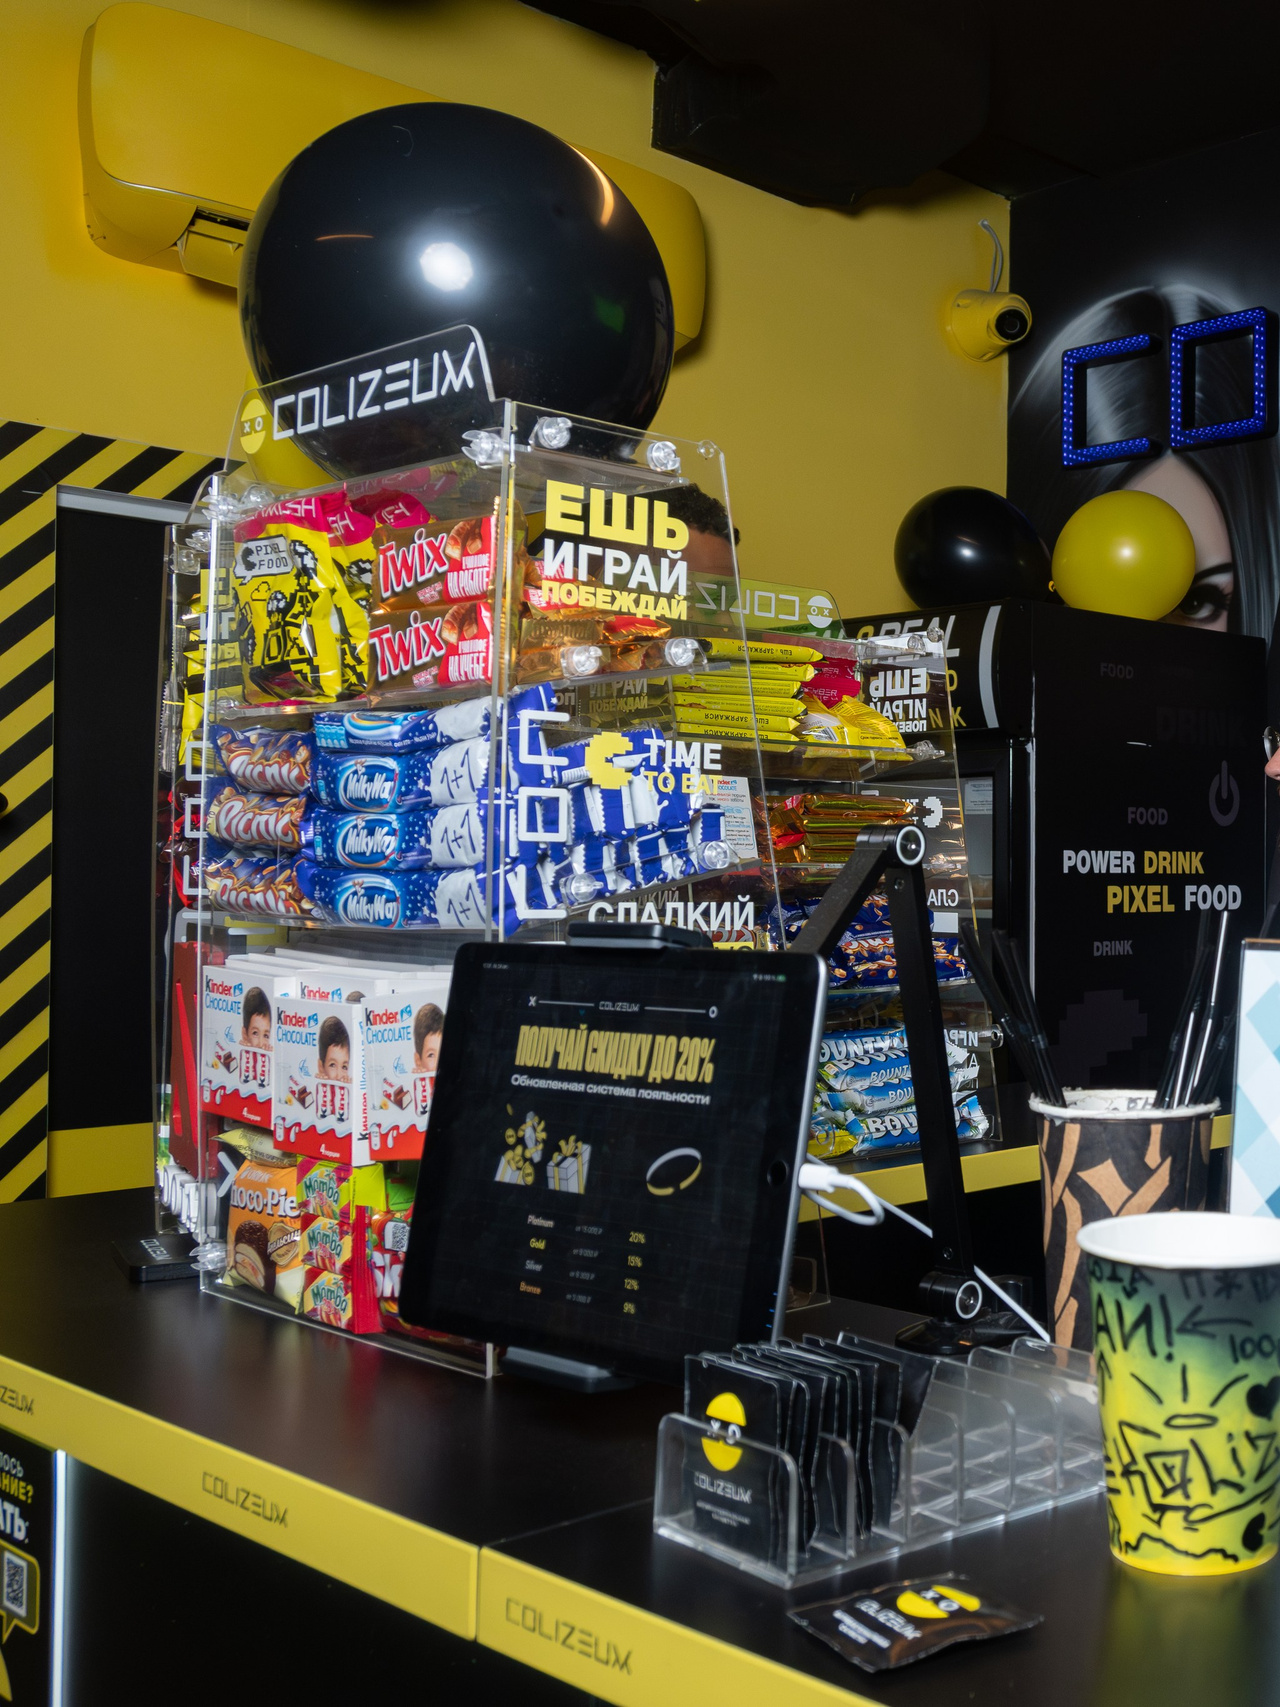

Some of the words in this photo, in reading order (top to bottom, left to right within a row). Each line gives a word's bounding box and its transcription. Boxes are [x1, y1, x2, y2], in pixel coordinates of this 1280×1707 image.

[273, 341, 476, 441] COLIZEUM
[545, 479, 689, 550] ЕШЬ
[257, 556, 289, 570] FOOD
[378, 527, 449, 599] Twix
[543, 537, 688, 597] ИГРАЙ
[541, 578, 688, 621] ПОБЕЖДАЙ
[369, 610, 446, 683] Twix
[643, 738, 723, 771] TIME
[644, 771, 676, 793] TO
[681, 773, 723, 795] EAT
[1127, 806, 1169, 826] FOOD
[1062, 850, 1136, 875] POWER
[1143, 850, 1205, 875] DRINK
[1106, 884, 1175, 914] PIXEL
[1184, 884, 1242, 911] FOOD
[1092, 939, 1134, 957] DRINK
[598, 1000, 640, 1013] COLIZEUM
[514, 1023, 588, 1071] ПОЛУЧАЙ
[584, 1029, 653, 1080] СКИДКУ
[647, 1033, 678, 1083] ДО
[674, 1036, 716, 1084] 20%
[819, 1036, 892, 1063] OUNTY
[870, 1064, 912, 1082] BOUNT
[511, 1074, 586, 1093] Обновленная
[586, 1082, 636, 1099] система
[637, 1088, 711, 1105] лояльности
[527, 1214, 555, 1228] Platinum
[529, 1237, 546, 1250] Gold
[628, 1231, 646, 1244] 20%
[525, 1259, 544, 1272] Silver
[627, 1254, 643, 1268] 15%
[519, 1281, 542, 1295] Bronze
[623, 1278, 640, 1291] 12%
[622, 1301, 636, 1315] 9%
[0, 1451, 24, 1478] ОСЬ
[202, 1471, 288, 1528] COLIZEUM
[694, 1471, 753, 1505] COLIZEUM
[505, 1596, 633, 1676] COLIZEUM
